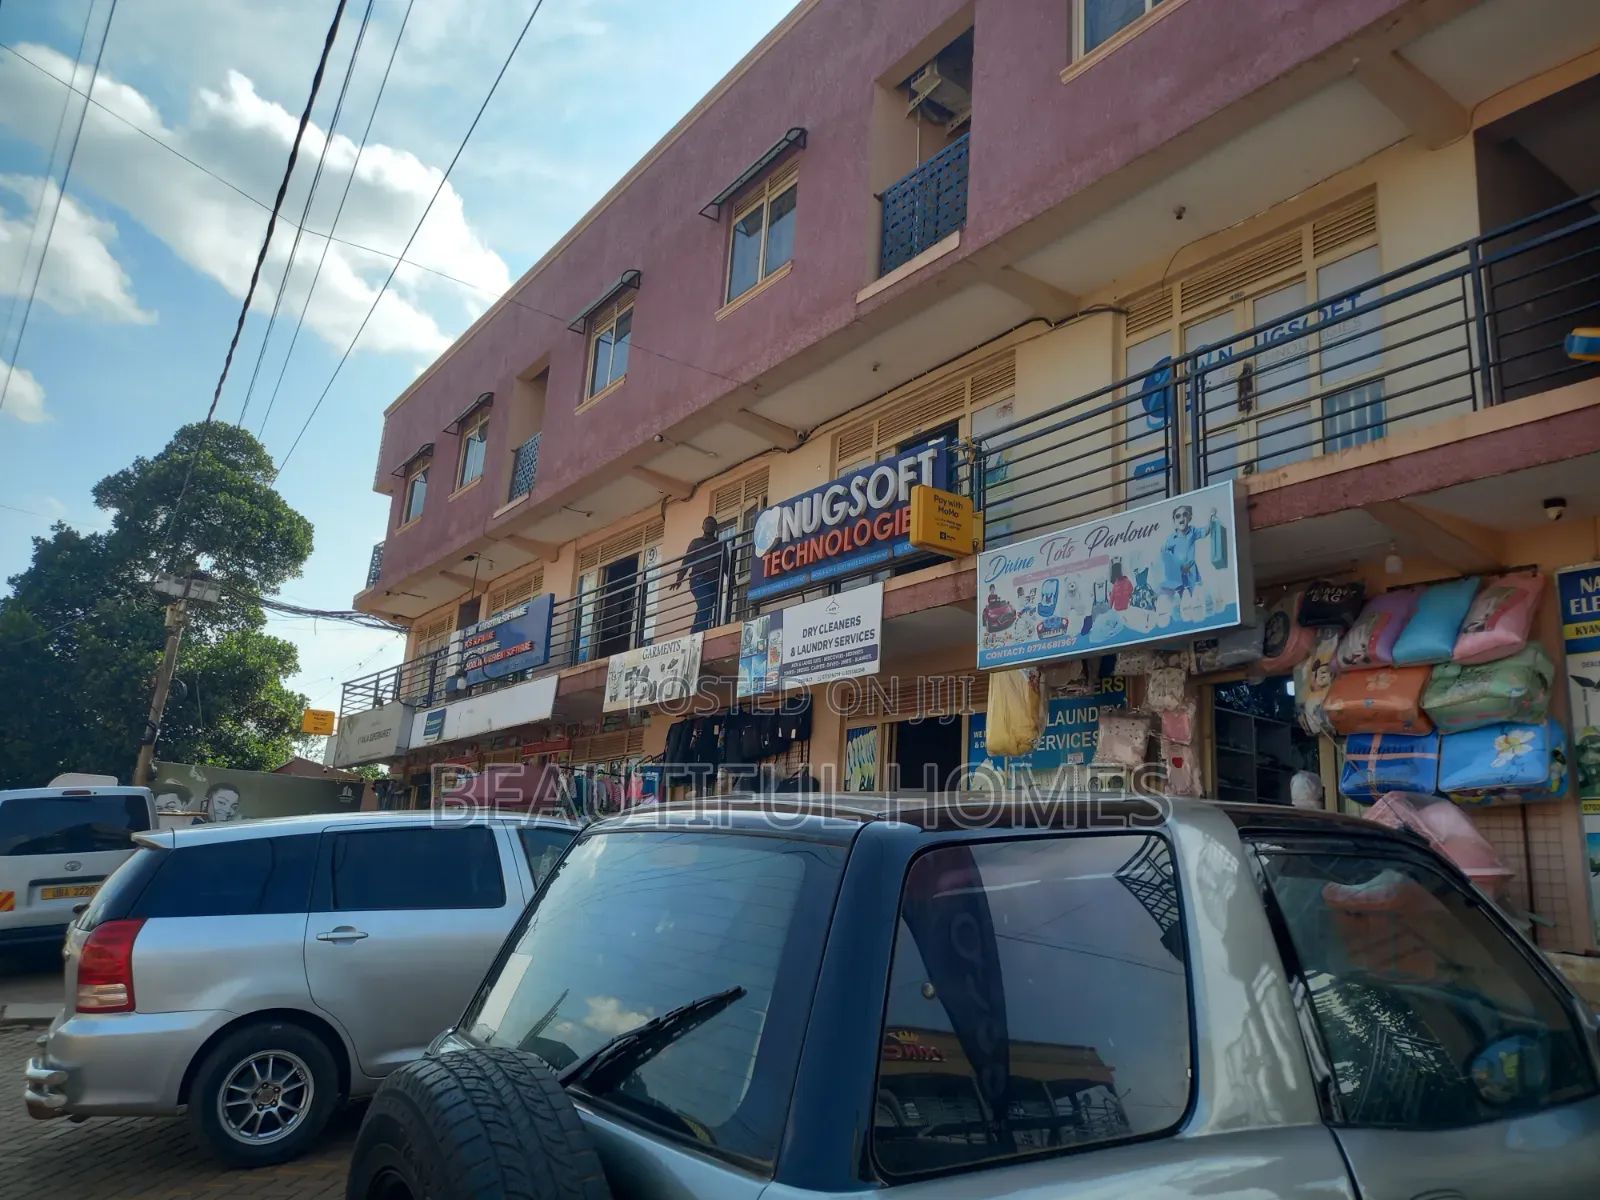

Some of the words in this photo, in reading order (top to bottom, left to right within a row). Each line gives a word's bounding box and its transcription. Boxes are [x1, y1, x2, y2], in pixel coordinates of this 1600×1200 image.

[781, 448, 938, 543] NUGSOFT
[933, 494, 947, 506] Pay
[949, 499, 963, 510] with
[938, 505, 959, 518] MoMo
[762, 504, 912, 579] TECHNOLOGIE
[984, 554, 1035, 584] Divine
[1039, 535, 1077, 566] Tots
[1084, 520, 1160, 557] Parlour
[802, 625, 820, 639] DRY
[819, 615, 861, 635] CLEANERS
[642, 639, 681, 660] GARMENTS
[790, 646, 796, 657] &
[797, 638, 835, 656] LAUNDRY
[834, 629, 875, 647] SERVICES
